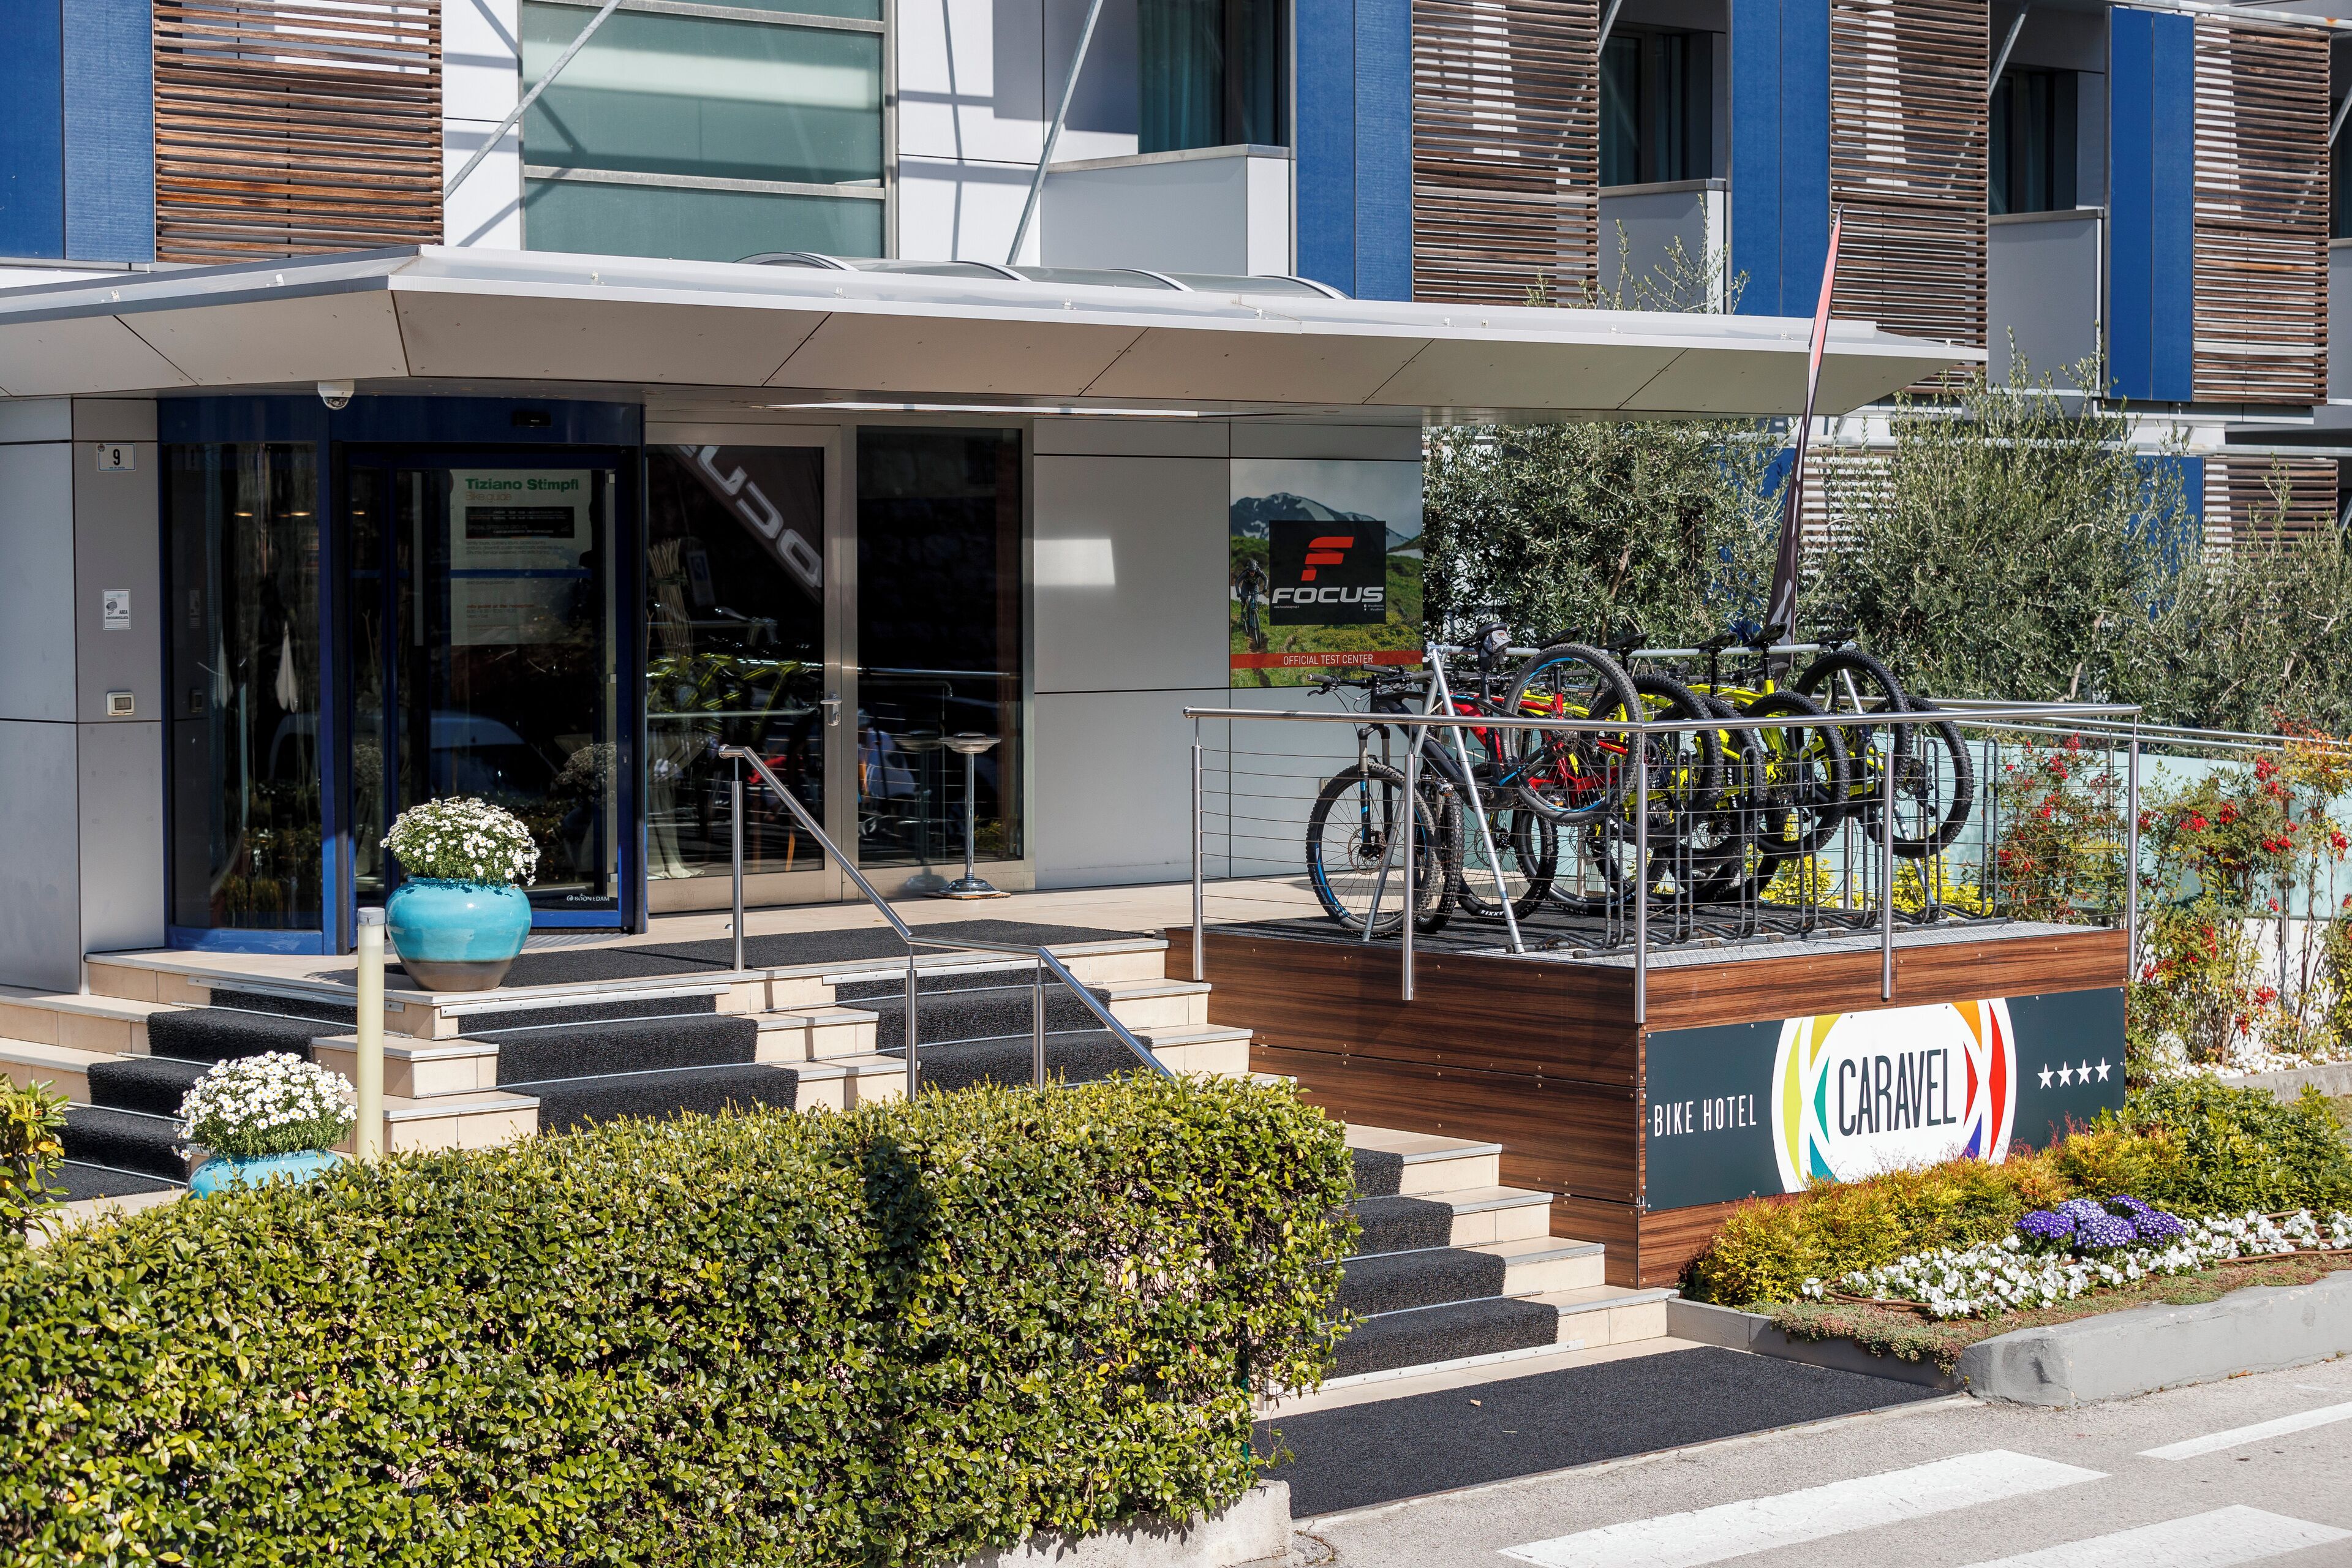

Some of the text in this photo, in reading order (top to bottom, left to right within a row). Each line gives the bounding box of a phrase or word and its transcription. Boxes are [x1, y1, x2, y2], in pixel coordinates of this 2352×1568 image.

[113, 449, 121, 466] 9
[465, 478, 522, 490] Tiziano
[466, 491, 512, 503] Bike guide
[1272, 587, 1384, 603] FOCUS
[1283, 654, 1374, 665] OFFICIAL TEST CENTER
[1838, 1047, 1957, 1137] CARAVEL
[1654, 1094, 1757, 1137] BIKE HOTEL
